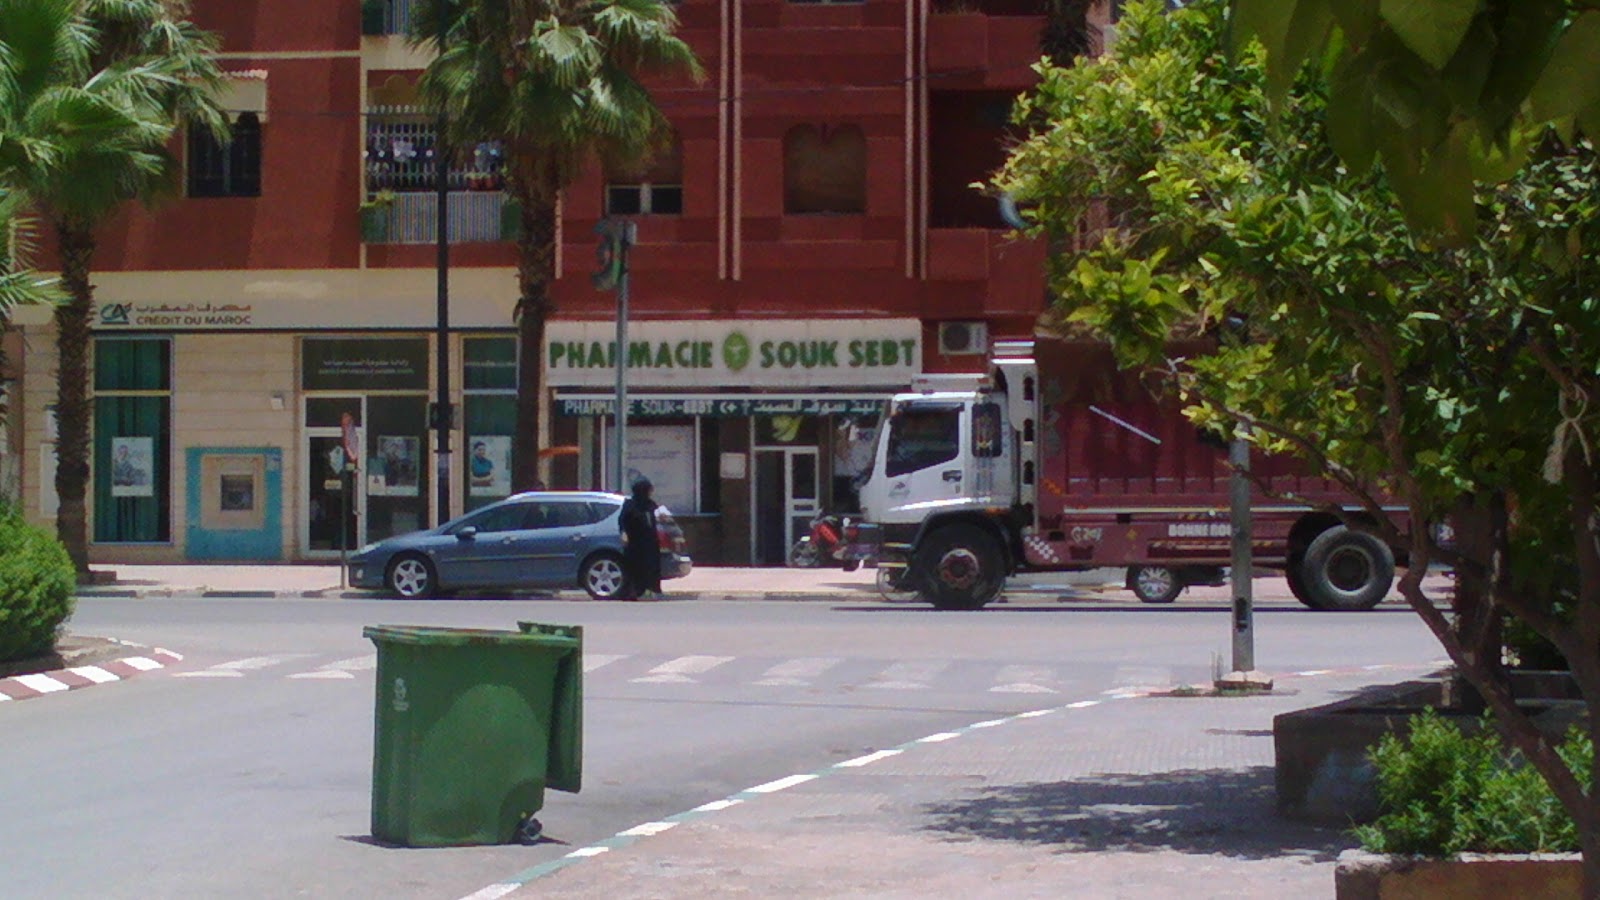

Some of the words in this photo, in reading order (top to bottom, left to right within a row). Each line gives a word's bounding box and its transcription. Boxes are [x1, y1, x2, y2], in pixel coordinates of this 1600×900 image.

[184, 316, 202, 325] DU
[205, 315, 251, 325] MAROC
[760, 341, 838, 368] SOUK
[849, 339, 915, 368] SEBT
[564, 400, 635, 415] PHARMAE
